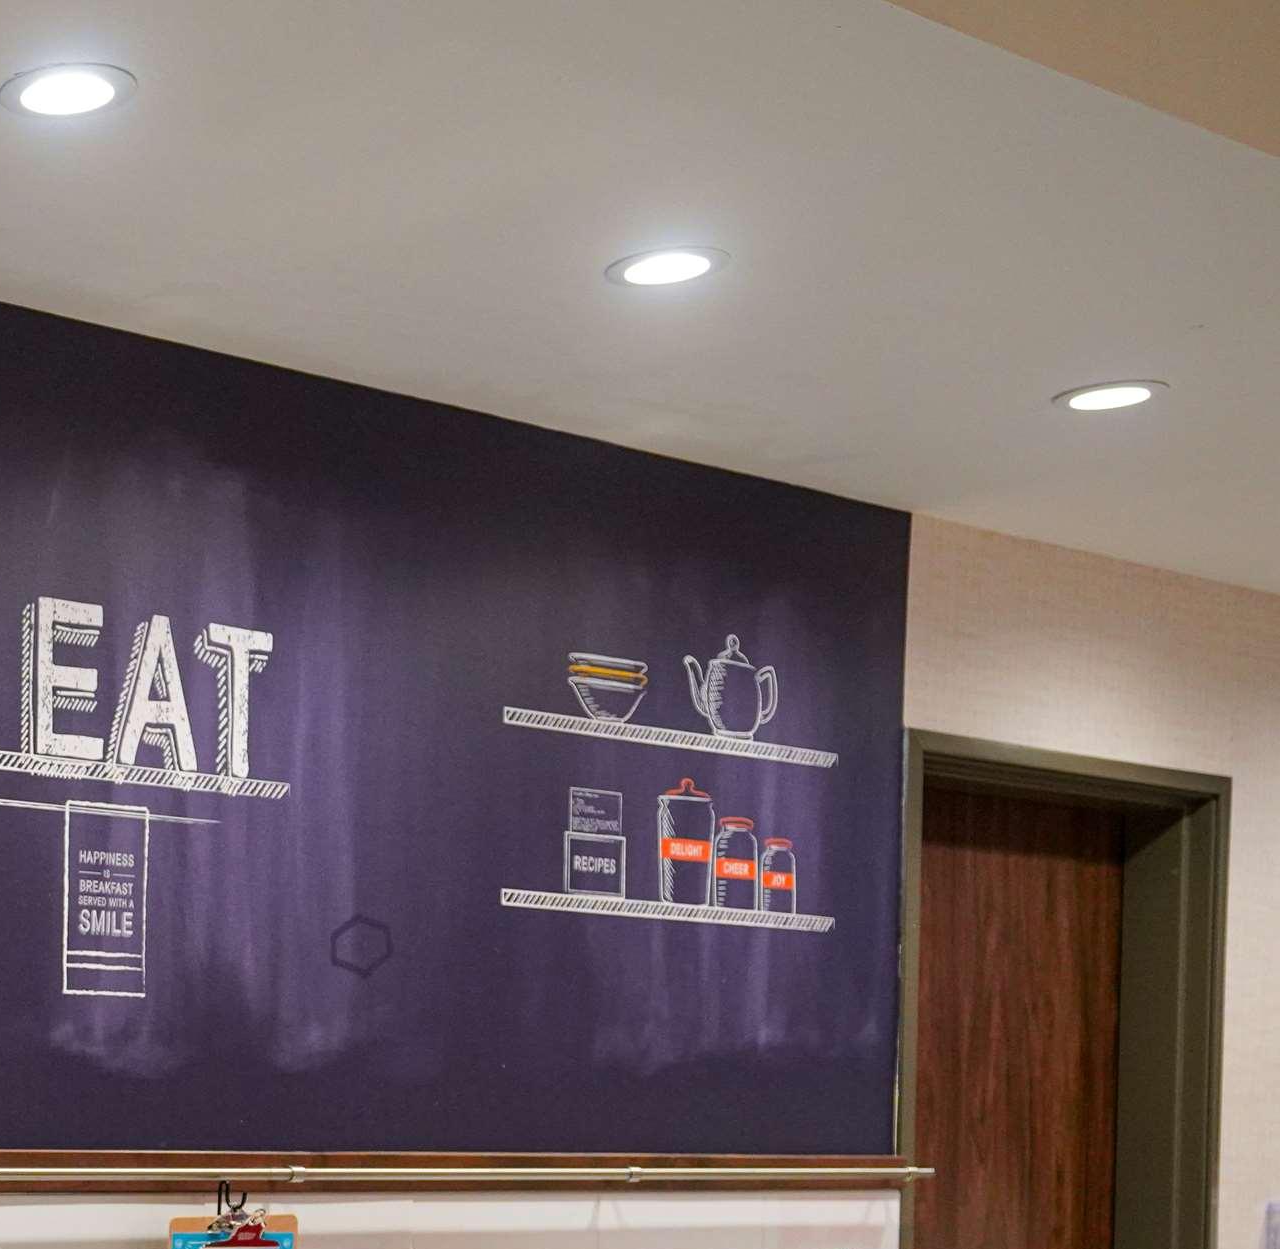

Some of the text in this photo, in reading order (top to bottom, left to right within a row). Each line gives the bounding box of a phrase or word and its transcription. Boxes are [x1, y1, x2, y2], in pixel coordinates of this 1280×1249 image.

[22, 596, 274, 780] EAT
[669, 842, 704, 857] DELIGHT
[79, 850, 135, 867] HAPPINESS
[573, 854, 617, 875] RECIPES
[722, 861, 749, 876] CHEER
[79, 879, 134, 896] BREAKFAST
[771, 875, 787, 886] JOY
[78, 895, 135, 909] SERVED WITH A
[78, 908, 134, 938] SMILE
